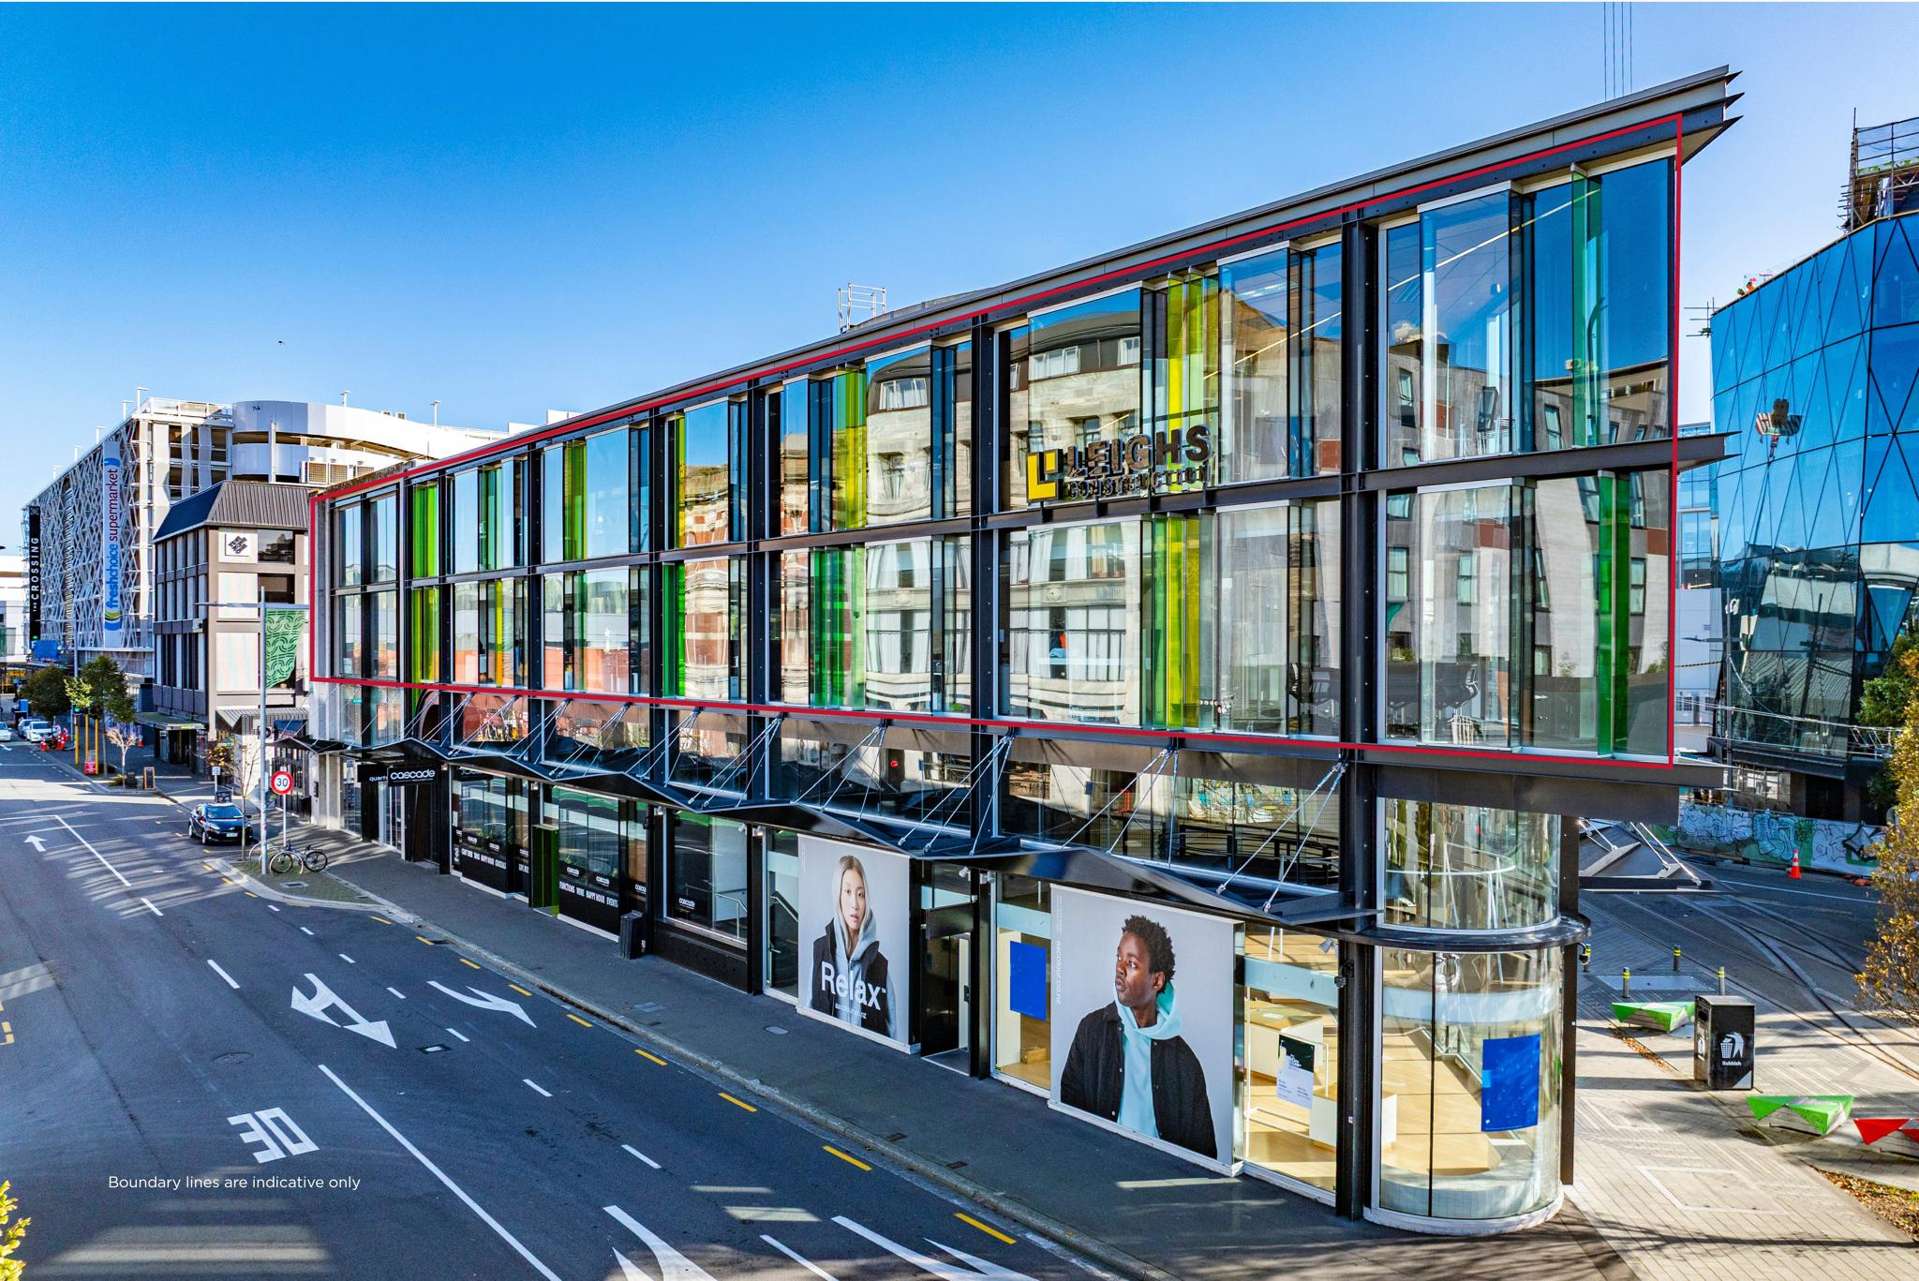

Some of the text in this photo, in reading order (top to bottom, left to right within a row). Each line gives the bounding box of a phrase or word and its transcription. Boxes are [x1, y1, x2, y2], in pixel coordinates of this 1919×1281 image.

[1067, 425, 1211, 478] LEIGHS
[105, 468, 120, 609] freshchoice supermarket
[31, 537, 40, 600] CROSSING
[277, 777, 288, 787] 30
[390, 769, 436, 780] cascade
[820, 961, 882, 1011] Relax
[227, 1107, 320, 1164] 30
